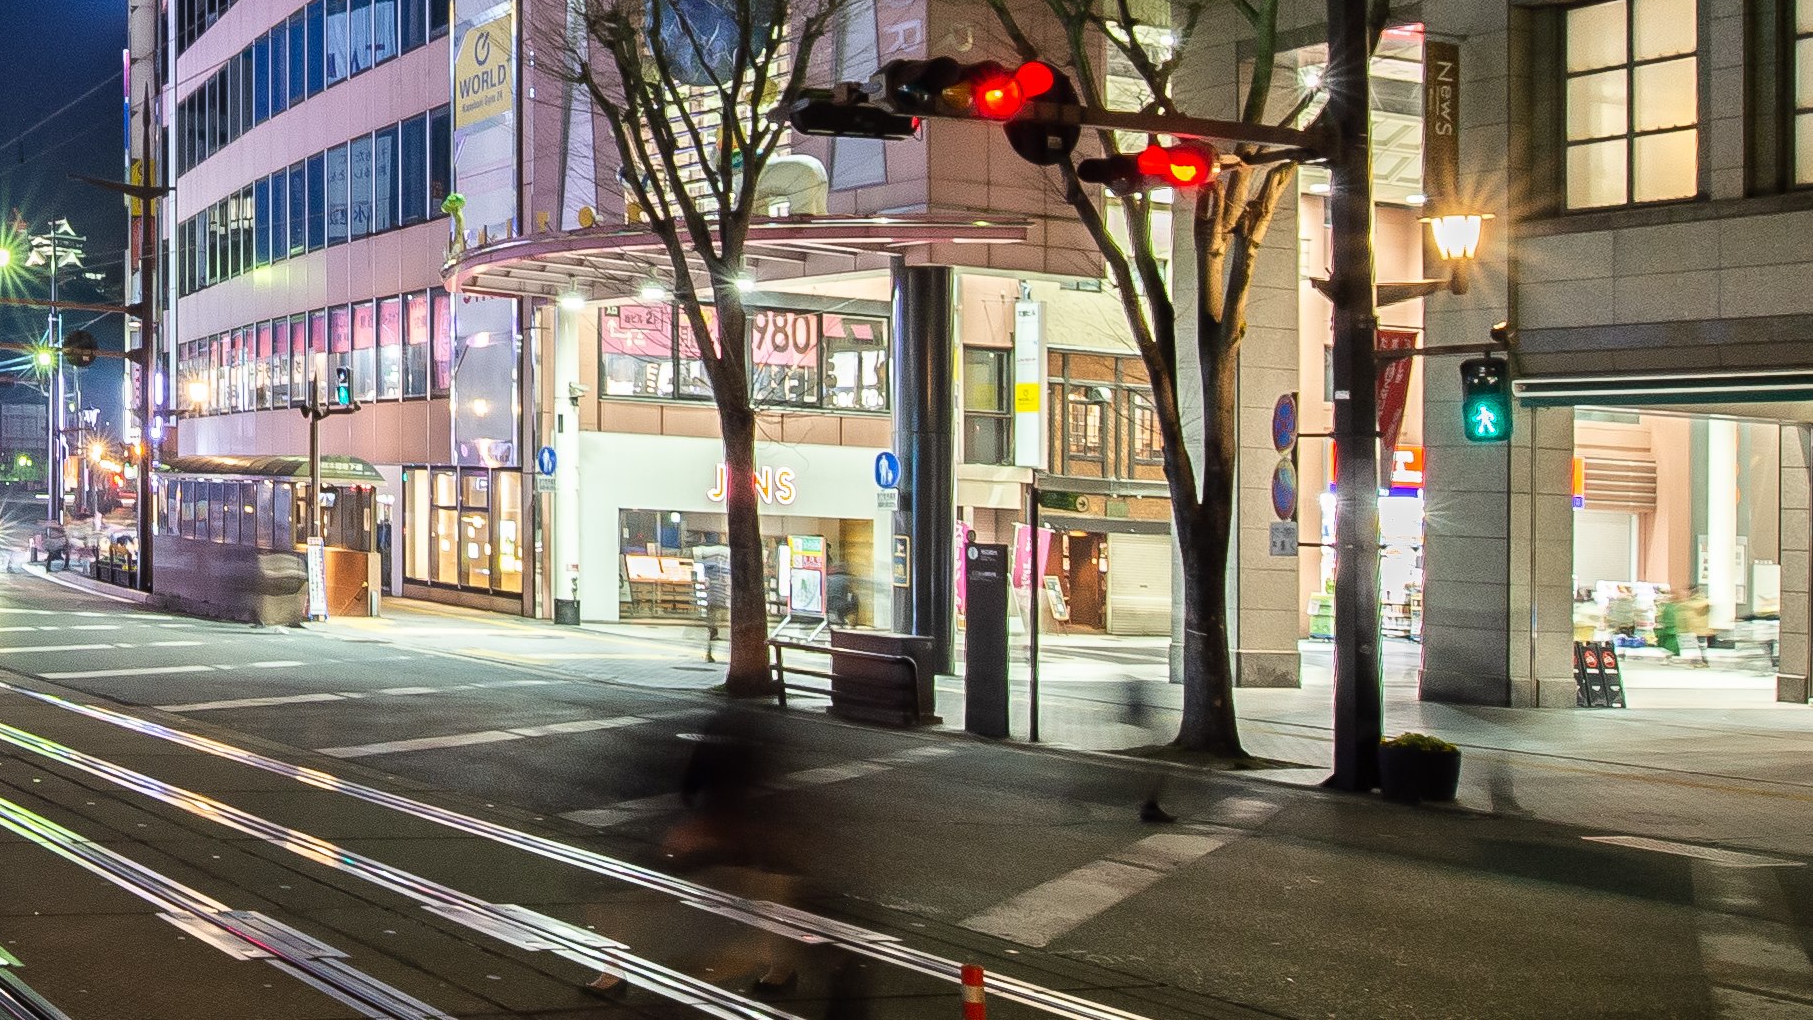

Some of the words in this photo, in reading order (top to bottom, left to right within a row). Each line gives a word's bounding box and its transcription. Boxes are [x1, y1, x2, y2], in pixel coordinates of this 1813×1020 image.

[459, 64, 506, 99] WORLD
[1435, 61, 1454, 136] News
[753, 313, 811, 356] 980
[707, 462, 798, 506] JNS
